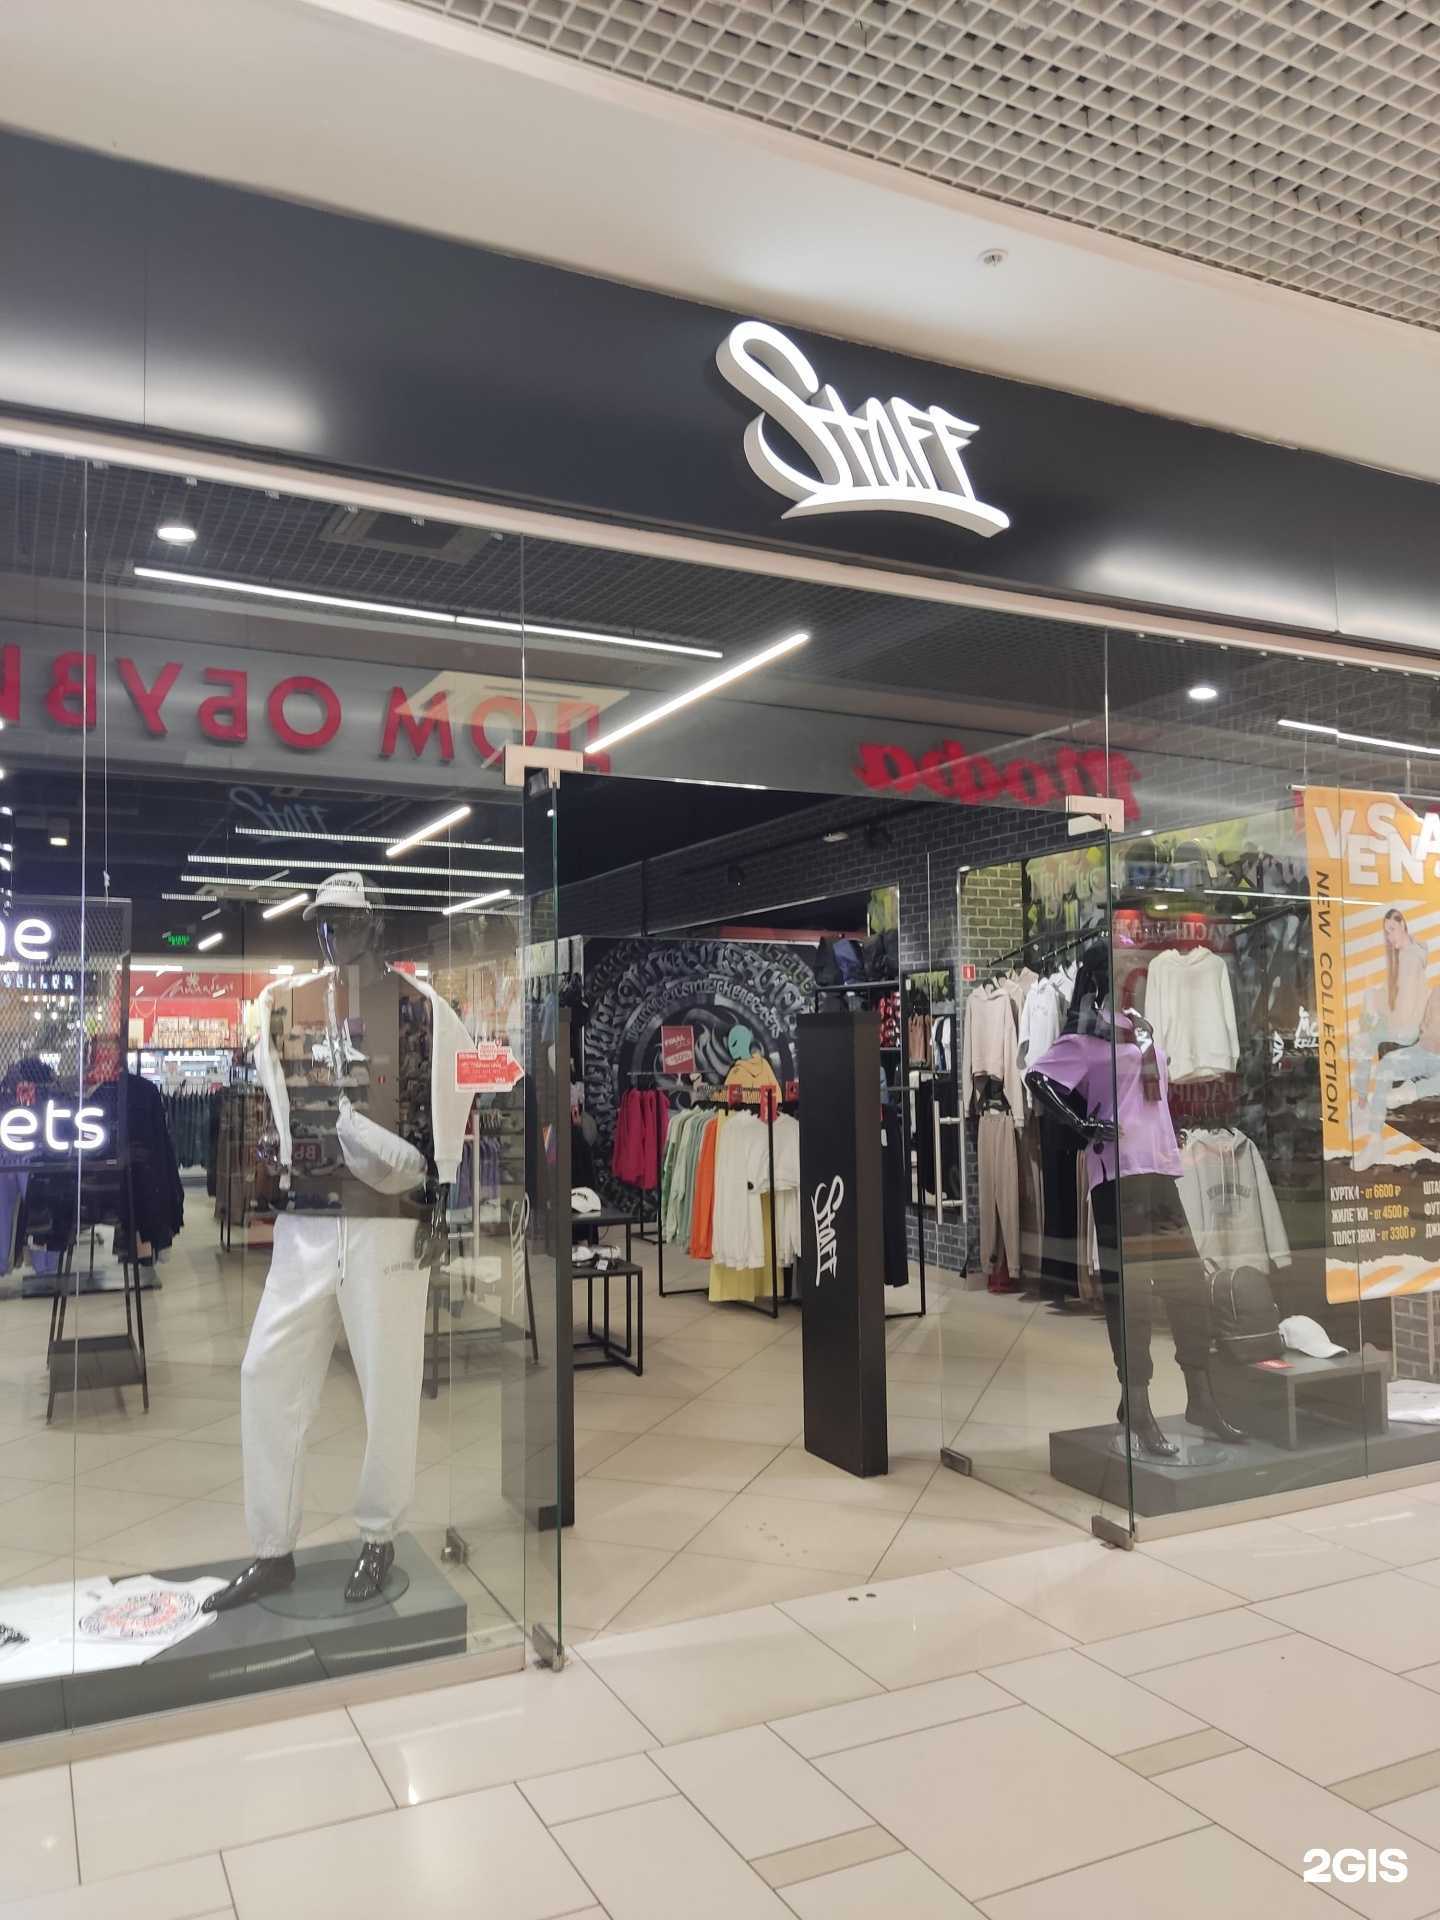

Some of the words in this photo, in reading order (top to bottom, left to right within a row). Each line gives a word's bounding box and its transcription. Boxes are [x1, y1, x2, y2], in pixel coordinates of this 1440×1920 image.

[1316, 871, 1331, 938] NEW
[1319, 952, 1339, 1124] COLLECTION
[1423, 1180, 1440, 1195] ШТА
